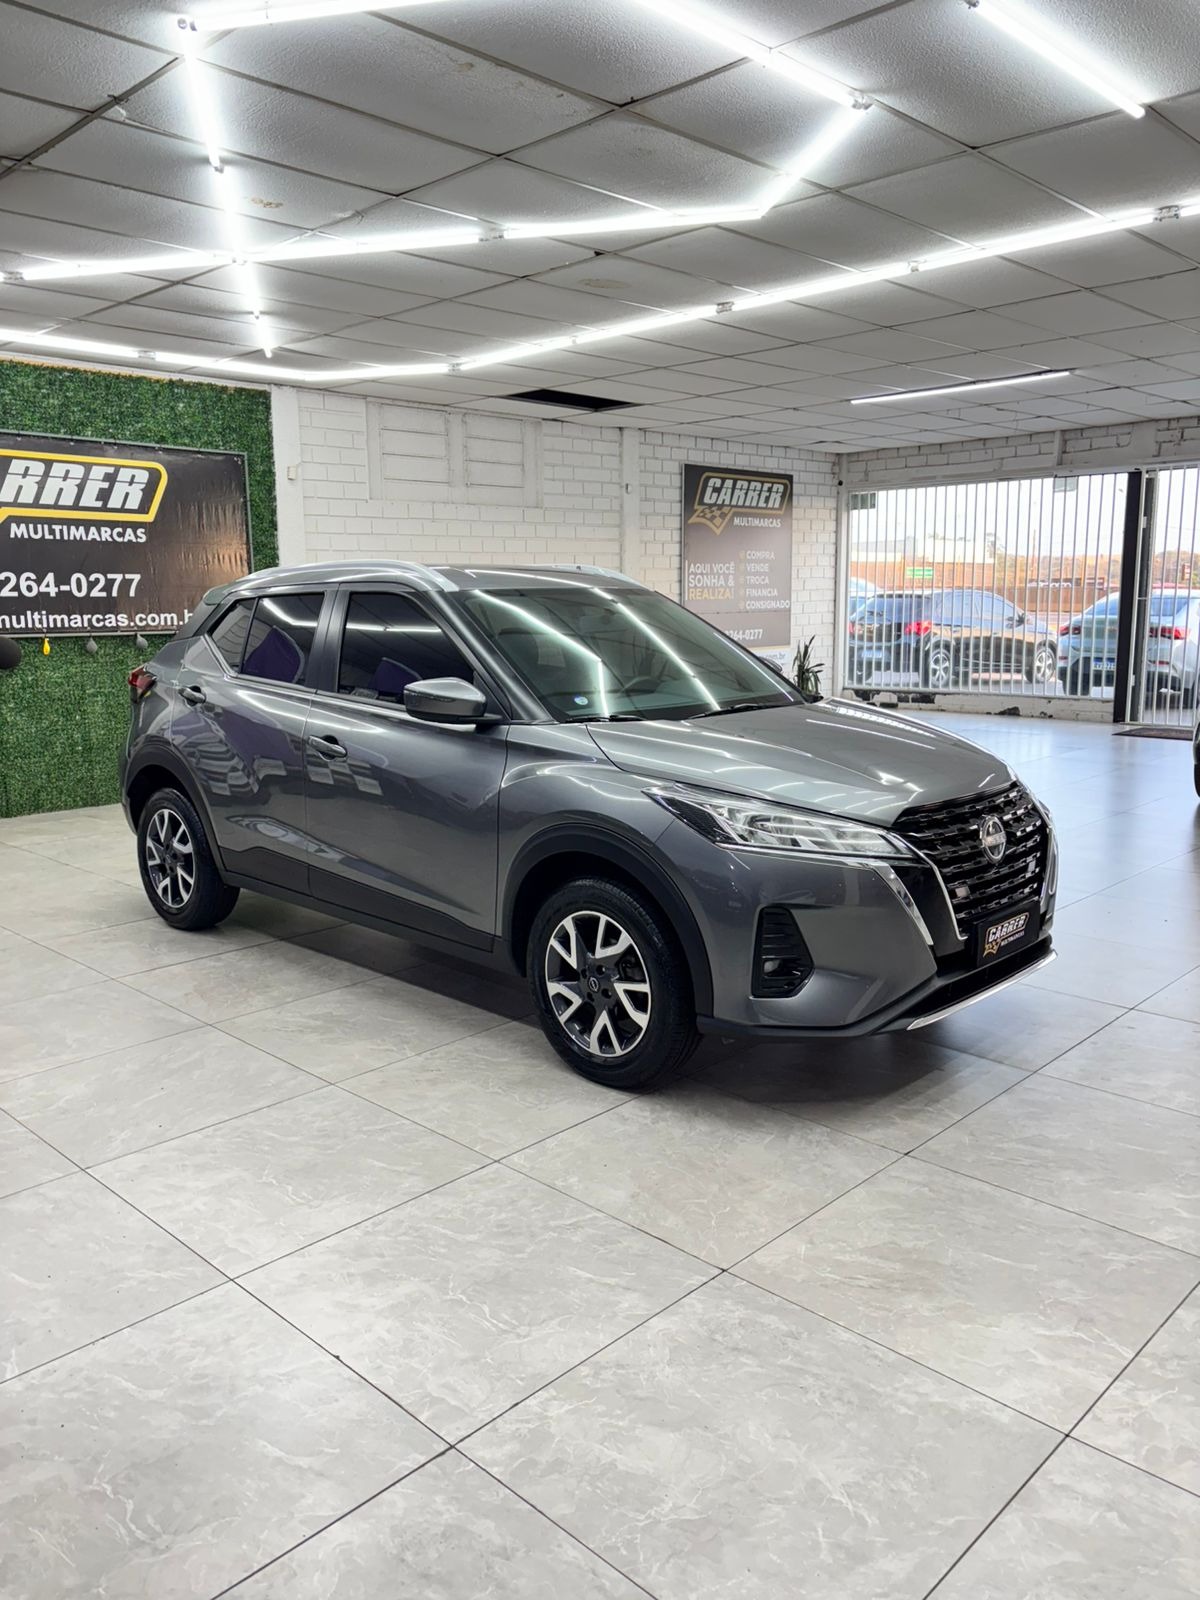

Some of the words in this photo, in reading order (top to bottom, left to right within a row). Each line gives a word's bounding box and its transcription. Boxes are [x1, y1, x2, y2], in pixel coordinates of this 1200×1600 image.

[703, 478, 784, 508] CARRER
[733, 517, 781, 528] MULTIMARCAS
[9, 522, 147, 543] MULTIMARCAS
[746, 550, 775, 560] COMPRA
[689, 563, 710, 574] AQUI
[713, 561, 735, 574] VOCÊ
[746, 563, 769, 572] VENDE
[0, 571, 141, 598] 264-0277
[688, 575, 725, 587] SONHA
[728, 575, 735, 587] &
[746, 576, 770, 585] TROCA
[746, 588, 778, 597] FINANCIA
[745, 600, 790, 609] CONSIGNADO
